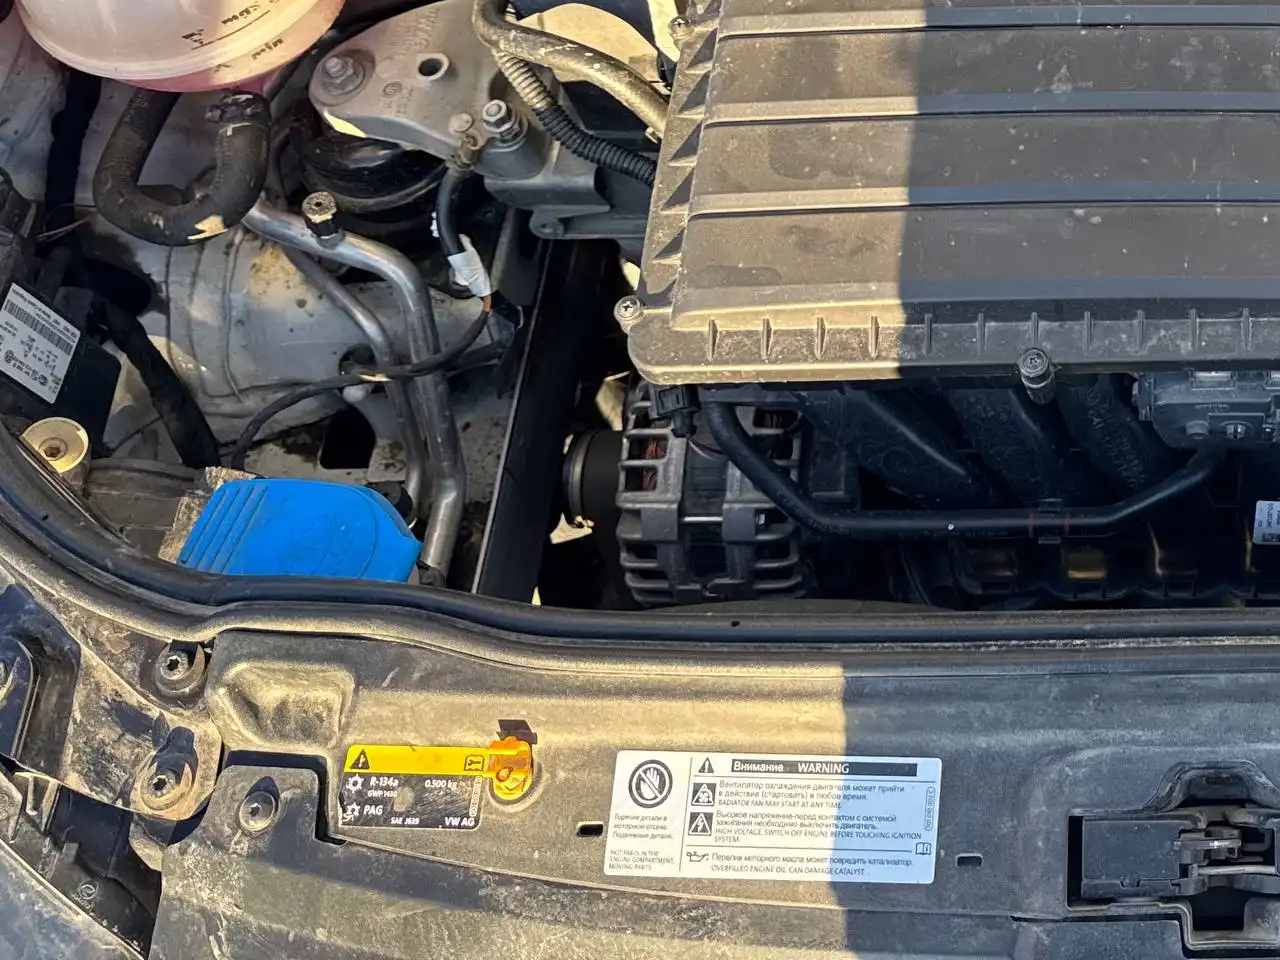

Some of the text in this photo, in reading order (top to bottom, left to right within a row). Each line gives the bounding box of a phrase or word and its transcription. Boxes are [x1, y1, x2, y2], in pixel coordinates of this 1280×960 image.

[733, 761, 784, 772] Внимание
[798, 762, 849, 774] WARNING
[369, 777, 398, 787] R-134a
[447, 780, 457, 790] kg
[719, 781, 764, 790] Вентилятор
[765, 783, 810, 791] охлаждения
[812, 784, 851, 792] двигателя
[878, 785, 905, 794] прийти
[367, 790, 384, 798] GWP
[724, 790, 759, 798] действие
[762, 791, 808, 800] (стартовать)
[719, 799, 749, 807] RADIATOR
[363, 805, 384, 816] PAG
[716, 810, 748, 819] Высокое
[445, 817, 475, 827] VW AG
[754, 820, 798, 828] необходимо
[804, 830, 828, 838] ENGINE
[830, 831, 854, 839] BEFORE
[891, 832, 922, 840] IGNITION
[744, 855, 781, 863] моторного
[711, 865, 748, 873] OVERFILLED
[750, 865, 775, 873] ENGINE
[788, 866, 803, 874] CAN
